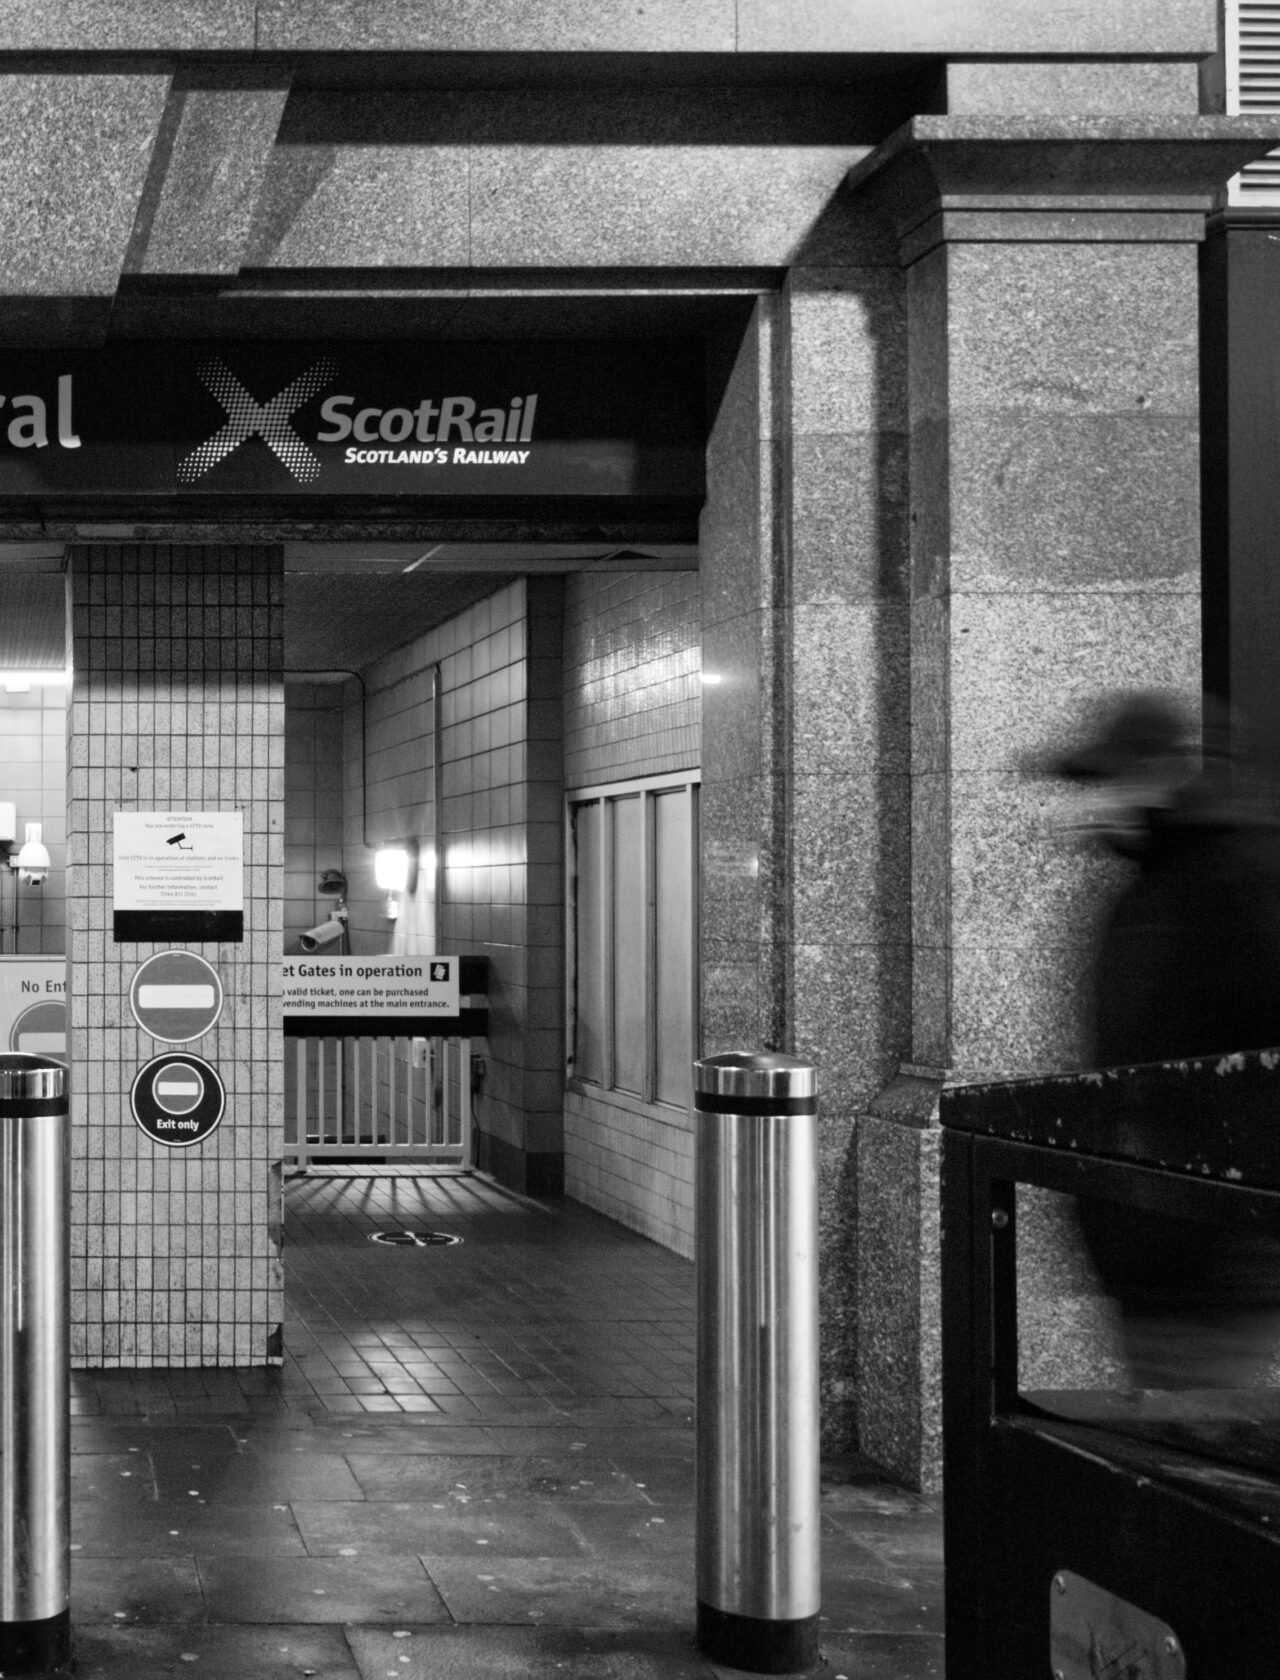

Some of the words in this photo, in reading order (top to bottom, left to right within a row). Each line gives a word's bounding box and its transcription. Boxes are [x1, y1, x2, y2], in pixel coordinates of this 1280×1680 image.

[317, 394, 538, 444] ScotRail
[453, 448, 530, 464] RAILWAY
[298, 964, 336, 977] Gates
[340, 964, 353, 977] in
[356, 964, 422, 980] operation
[21, 980, 40, 993] No
[287, 987, 308, 996] valid
[310, 987, 337, 997] ticket,
[339, 988, 355, 996] one
[356, 988, 371, 996] can
[373, 987, 384, 996] be
[385, 987, 429, 998] purchased
[317, 999, 358, 1008] machines
[359, 1000, 369, 1008] at
[370, 999, 384, 1008] the
[386, 999, 408, 1008] main
[409, 1000, 450, 1008] entrance.
[156, 1119, 176, 1129] Exit
[177, 1119, 199, 1132] only
